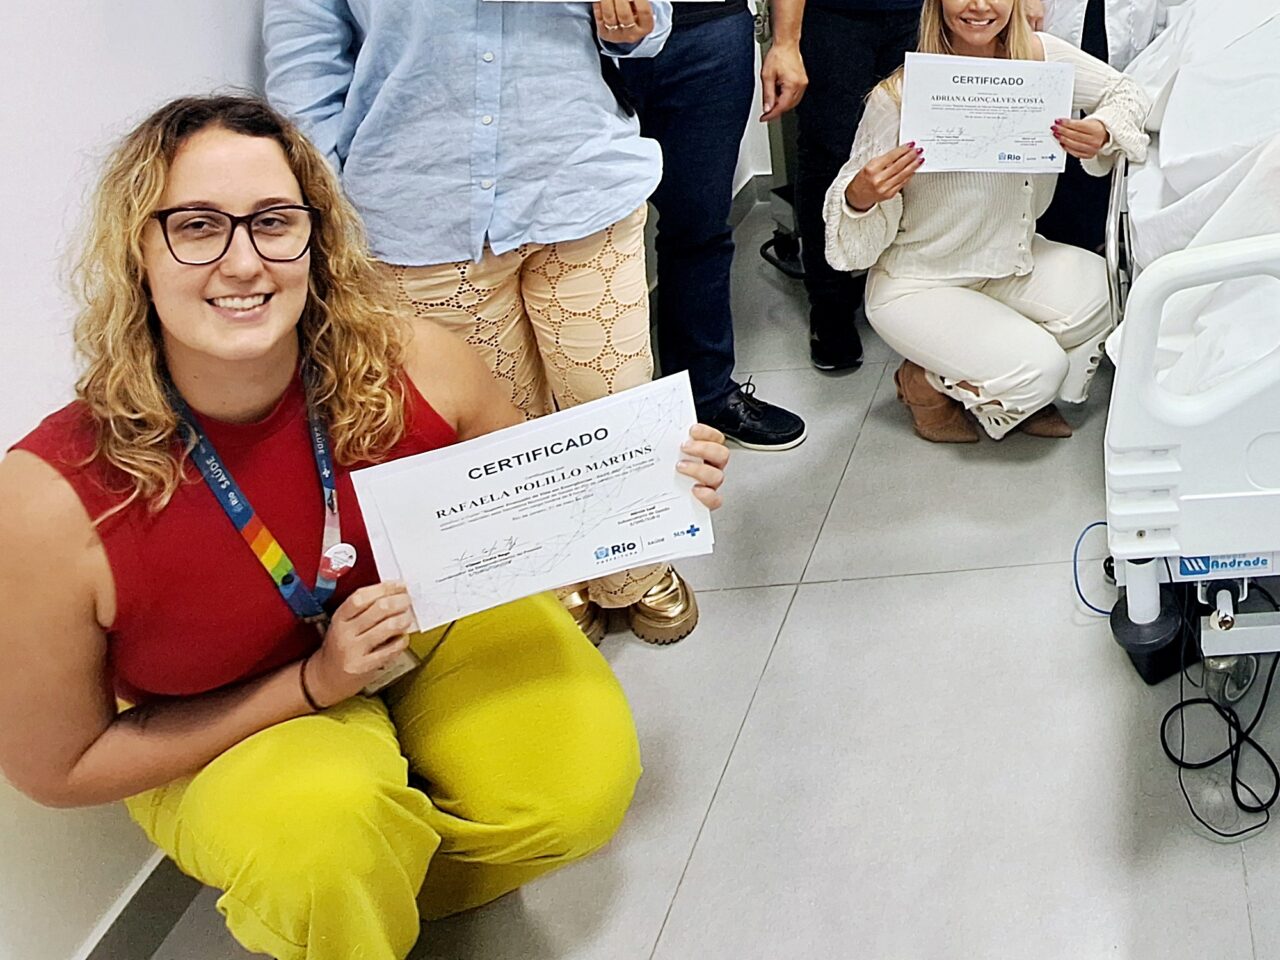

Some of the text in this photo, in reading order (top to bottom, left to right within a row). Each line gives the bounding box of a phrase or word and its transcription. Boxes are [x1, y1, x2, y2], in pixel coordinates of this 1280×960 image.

[952, 75, 1024, 86] CERTIFICADO
[468, 428, 609, 481] CERTIFICADO
[206, 456, 231, 489] SAÚDE
[436, 490, 511, 519] RAFAELA
[514, 467, 582, 495] POLILLO
[586, 444, 653, 474] MARTINS
[611, 542, 636, 555] Rio
[1211, 557, 1268, 569] Andrade
